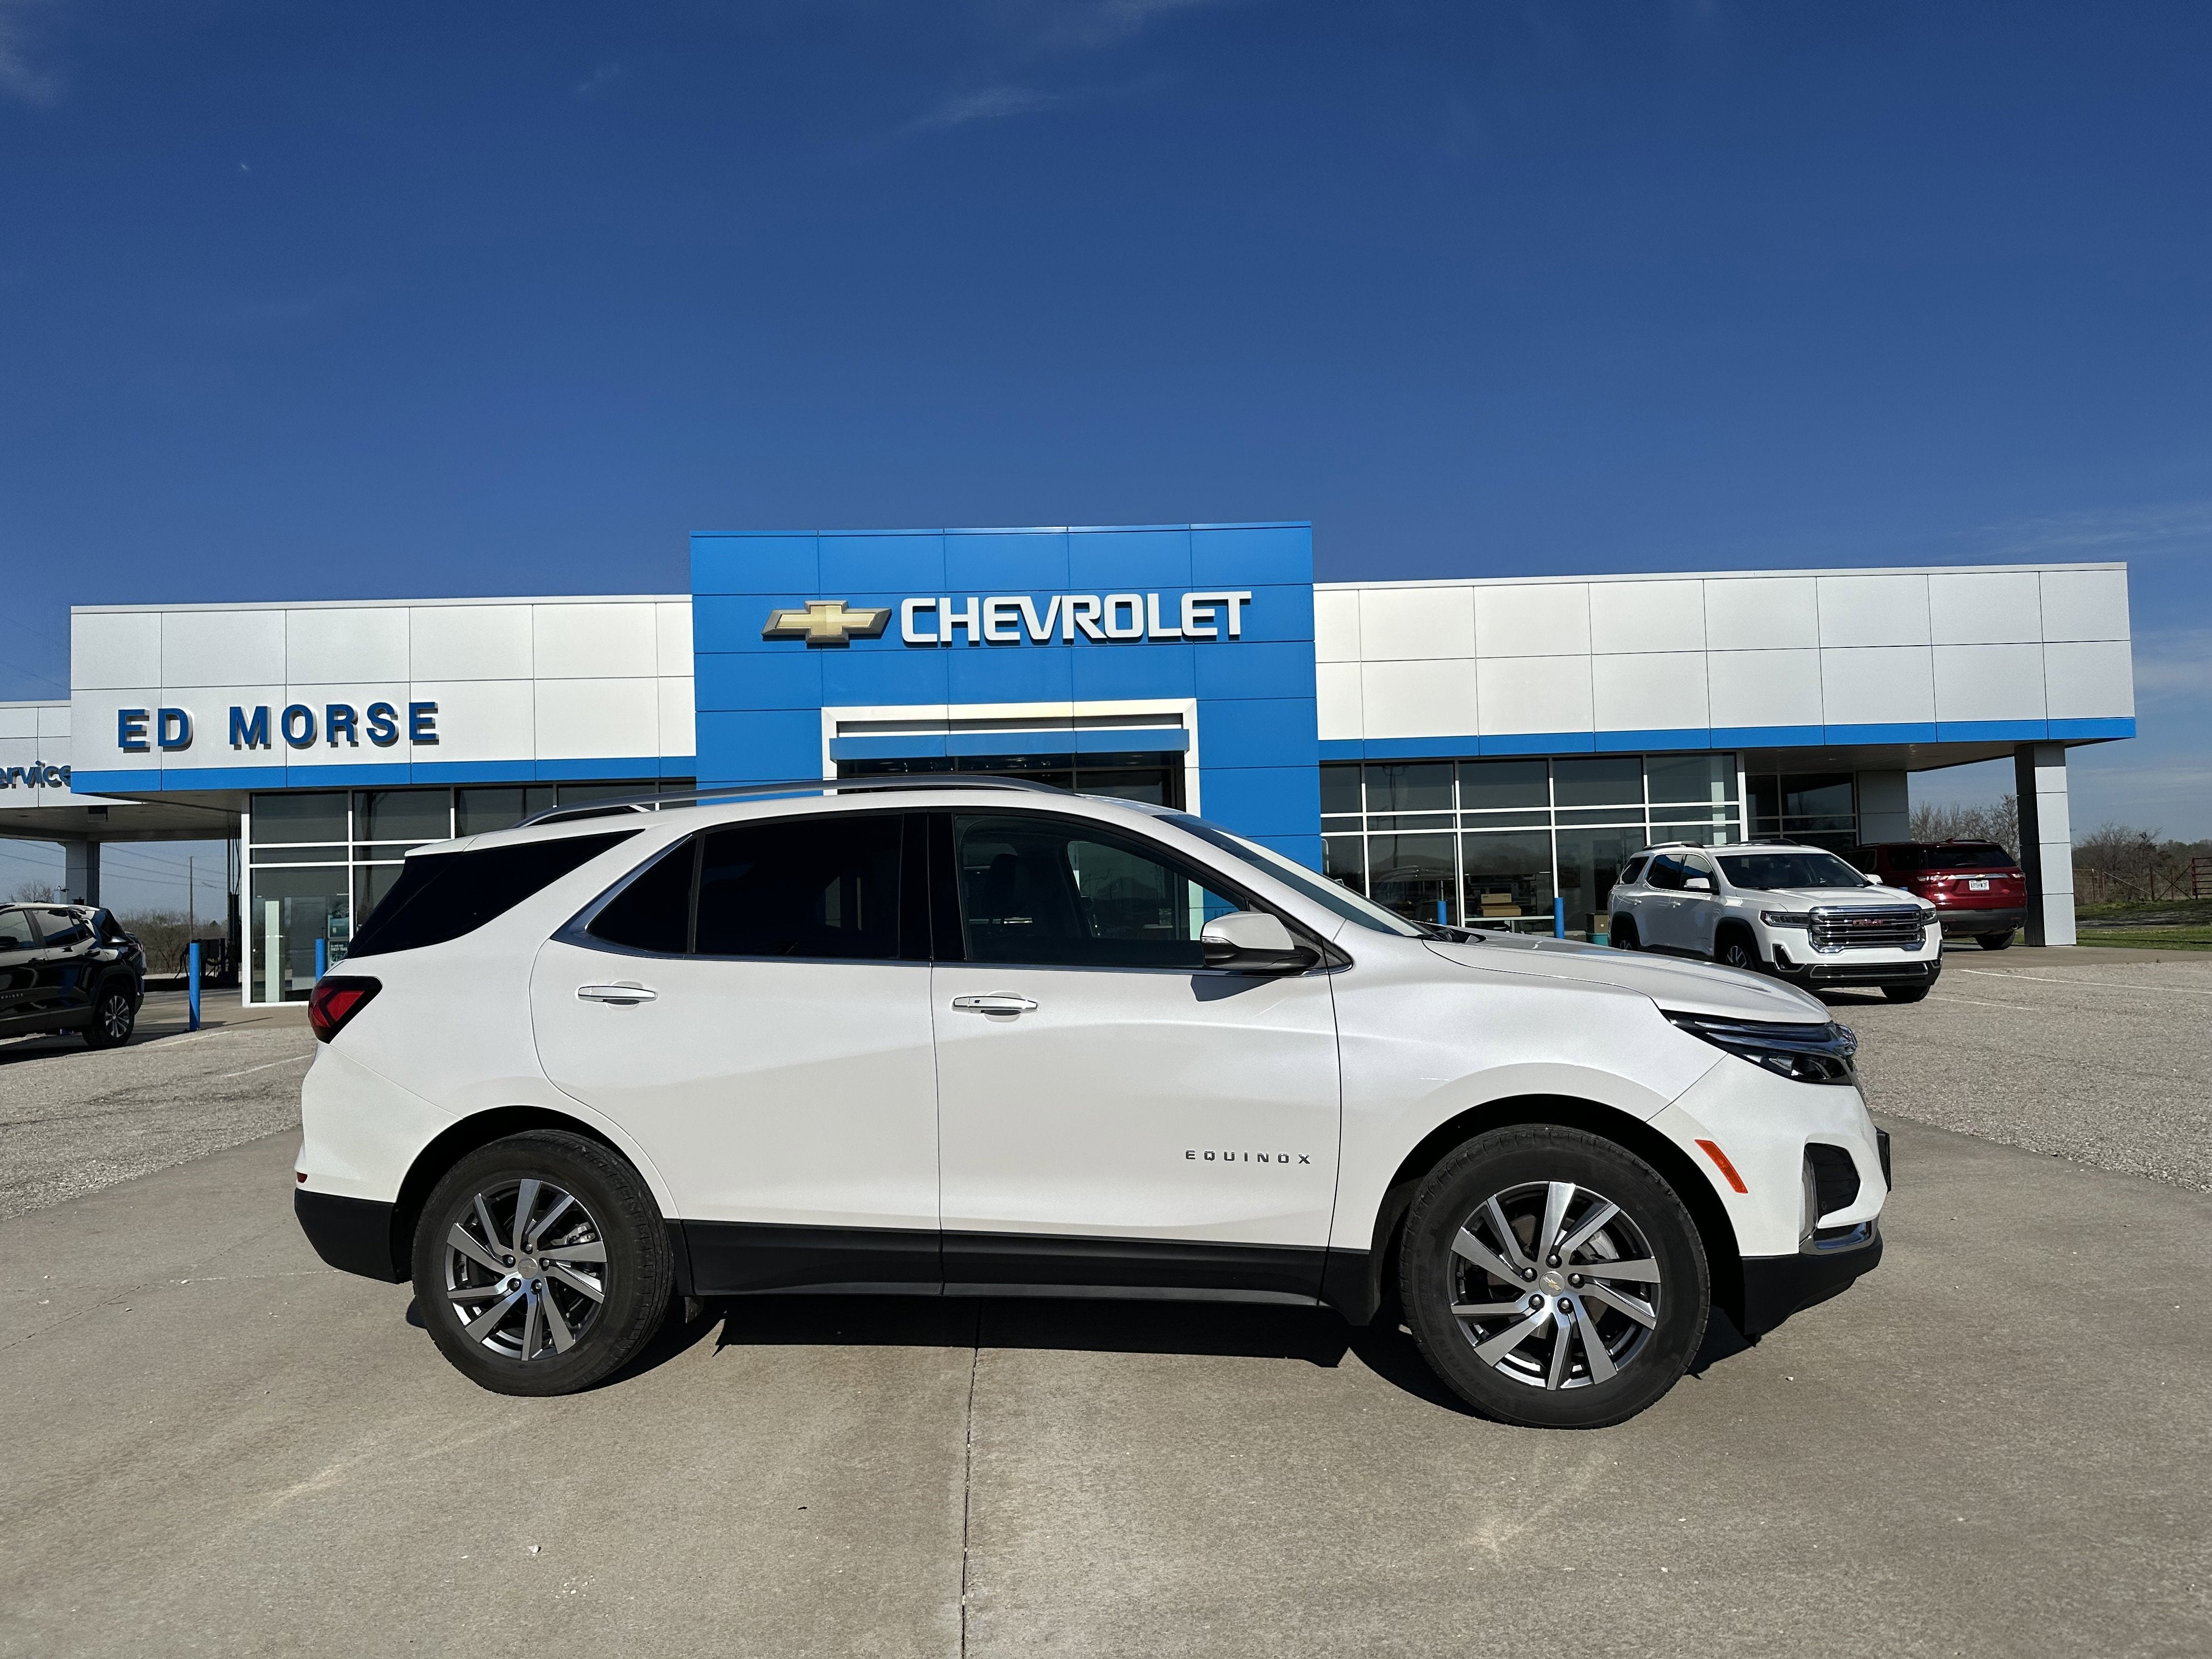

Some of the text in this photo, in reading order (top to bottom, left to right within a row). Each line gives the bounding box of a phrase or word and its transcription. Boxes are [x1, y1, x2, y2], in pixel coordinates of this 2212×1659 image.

[901, 591, 1252, 642] CHEVROLET
[118, 702, 439, 752] ED MORSE
[1185, 1149, 1311, 1165] EQUINOX
